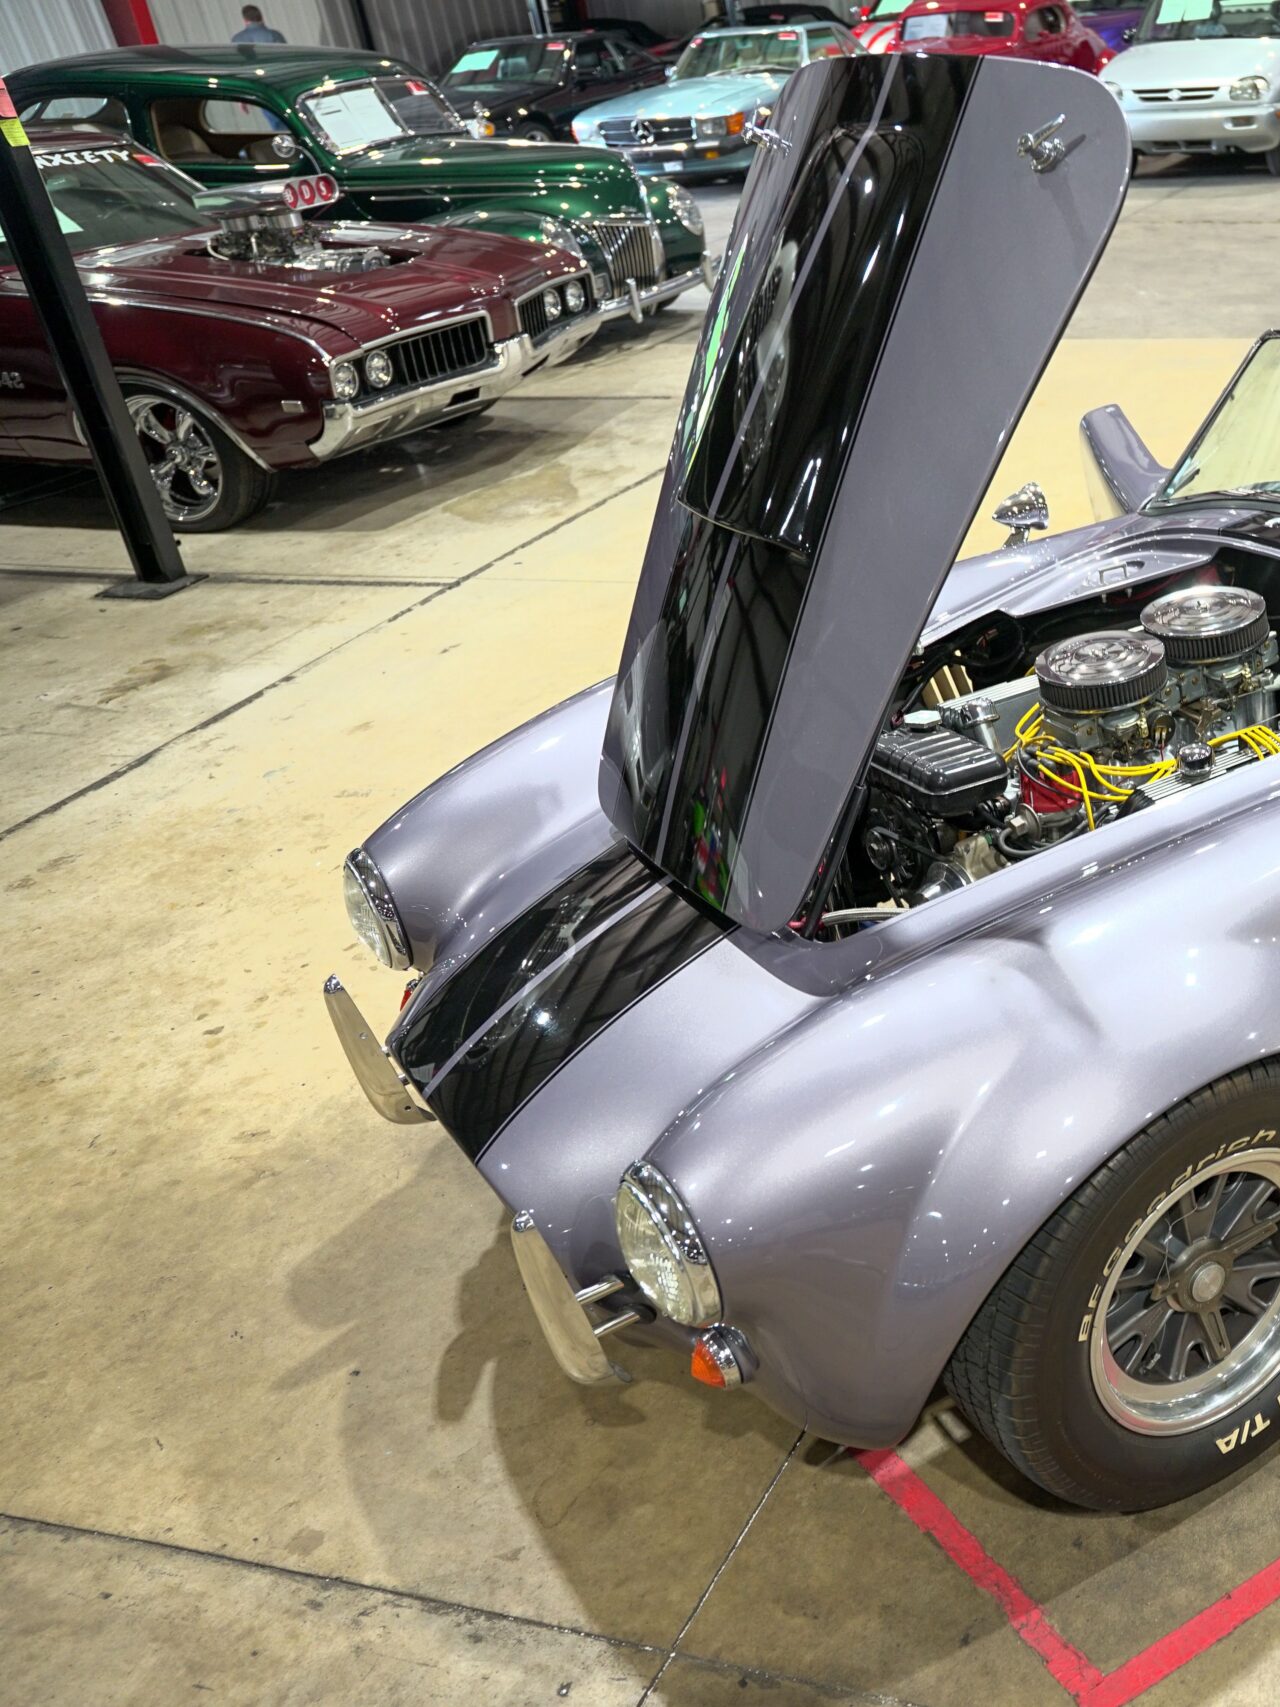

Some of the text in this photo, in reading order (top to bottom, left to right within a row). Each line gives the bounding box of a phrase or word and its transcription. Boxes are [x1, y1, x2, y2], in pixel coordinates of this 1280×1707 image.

[33, 150, 129, 170] NXIETY
[284, 181, 331, 203] BDS
[0, 371, 25, 389] 42
[1078, 1129, 1277, 1342] BFGoodrich
[1215, 1412, 1271, 1455] T/A
